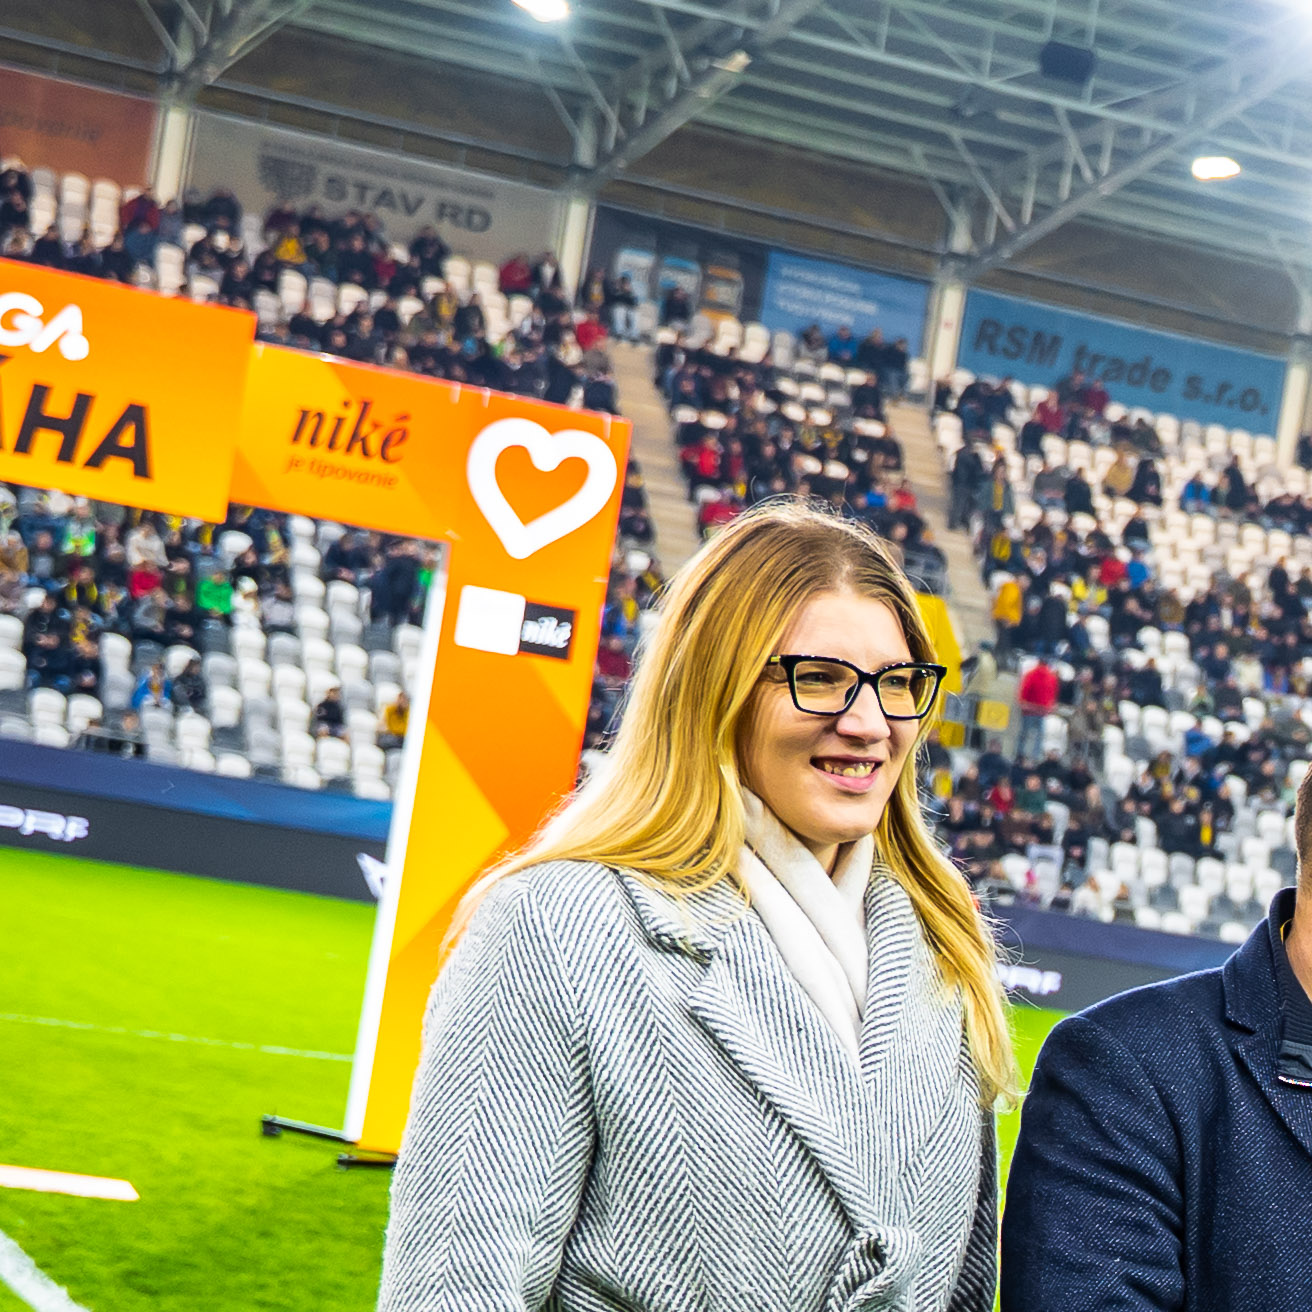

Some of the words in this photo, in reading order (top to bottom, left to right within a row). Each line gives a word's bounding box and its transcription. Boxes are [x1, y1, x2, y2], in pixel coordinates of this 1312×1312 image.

[324, 174, 425, 217] STAV
[435, 201, 493, 233] RD
[975, 317, 1062, 367] RSM
[1072, 344, 1173, 394] trade
[1182, 375, 1269, 415] s.r.o.
[0, 354, 152, 478] HA
[292, 400, 411, 464] niké
